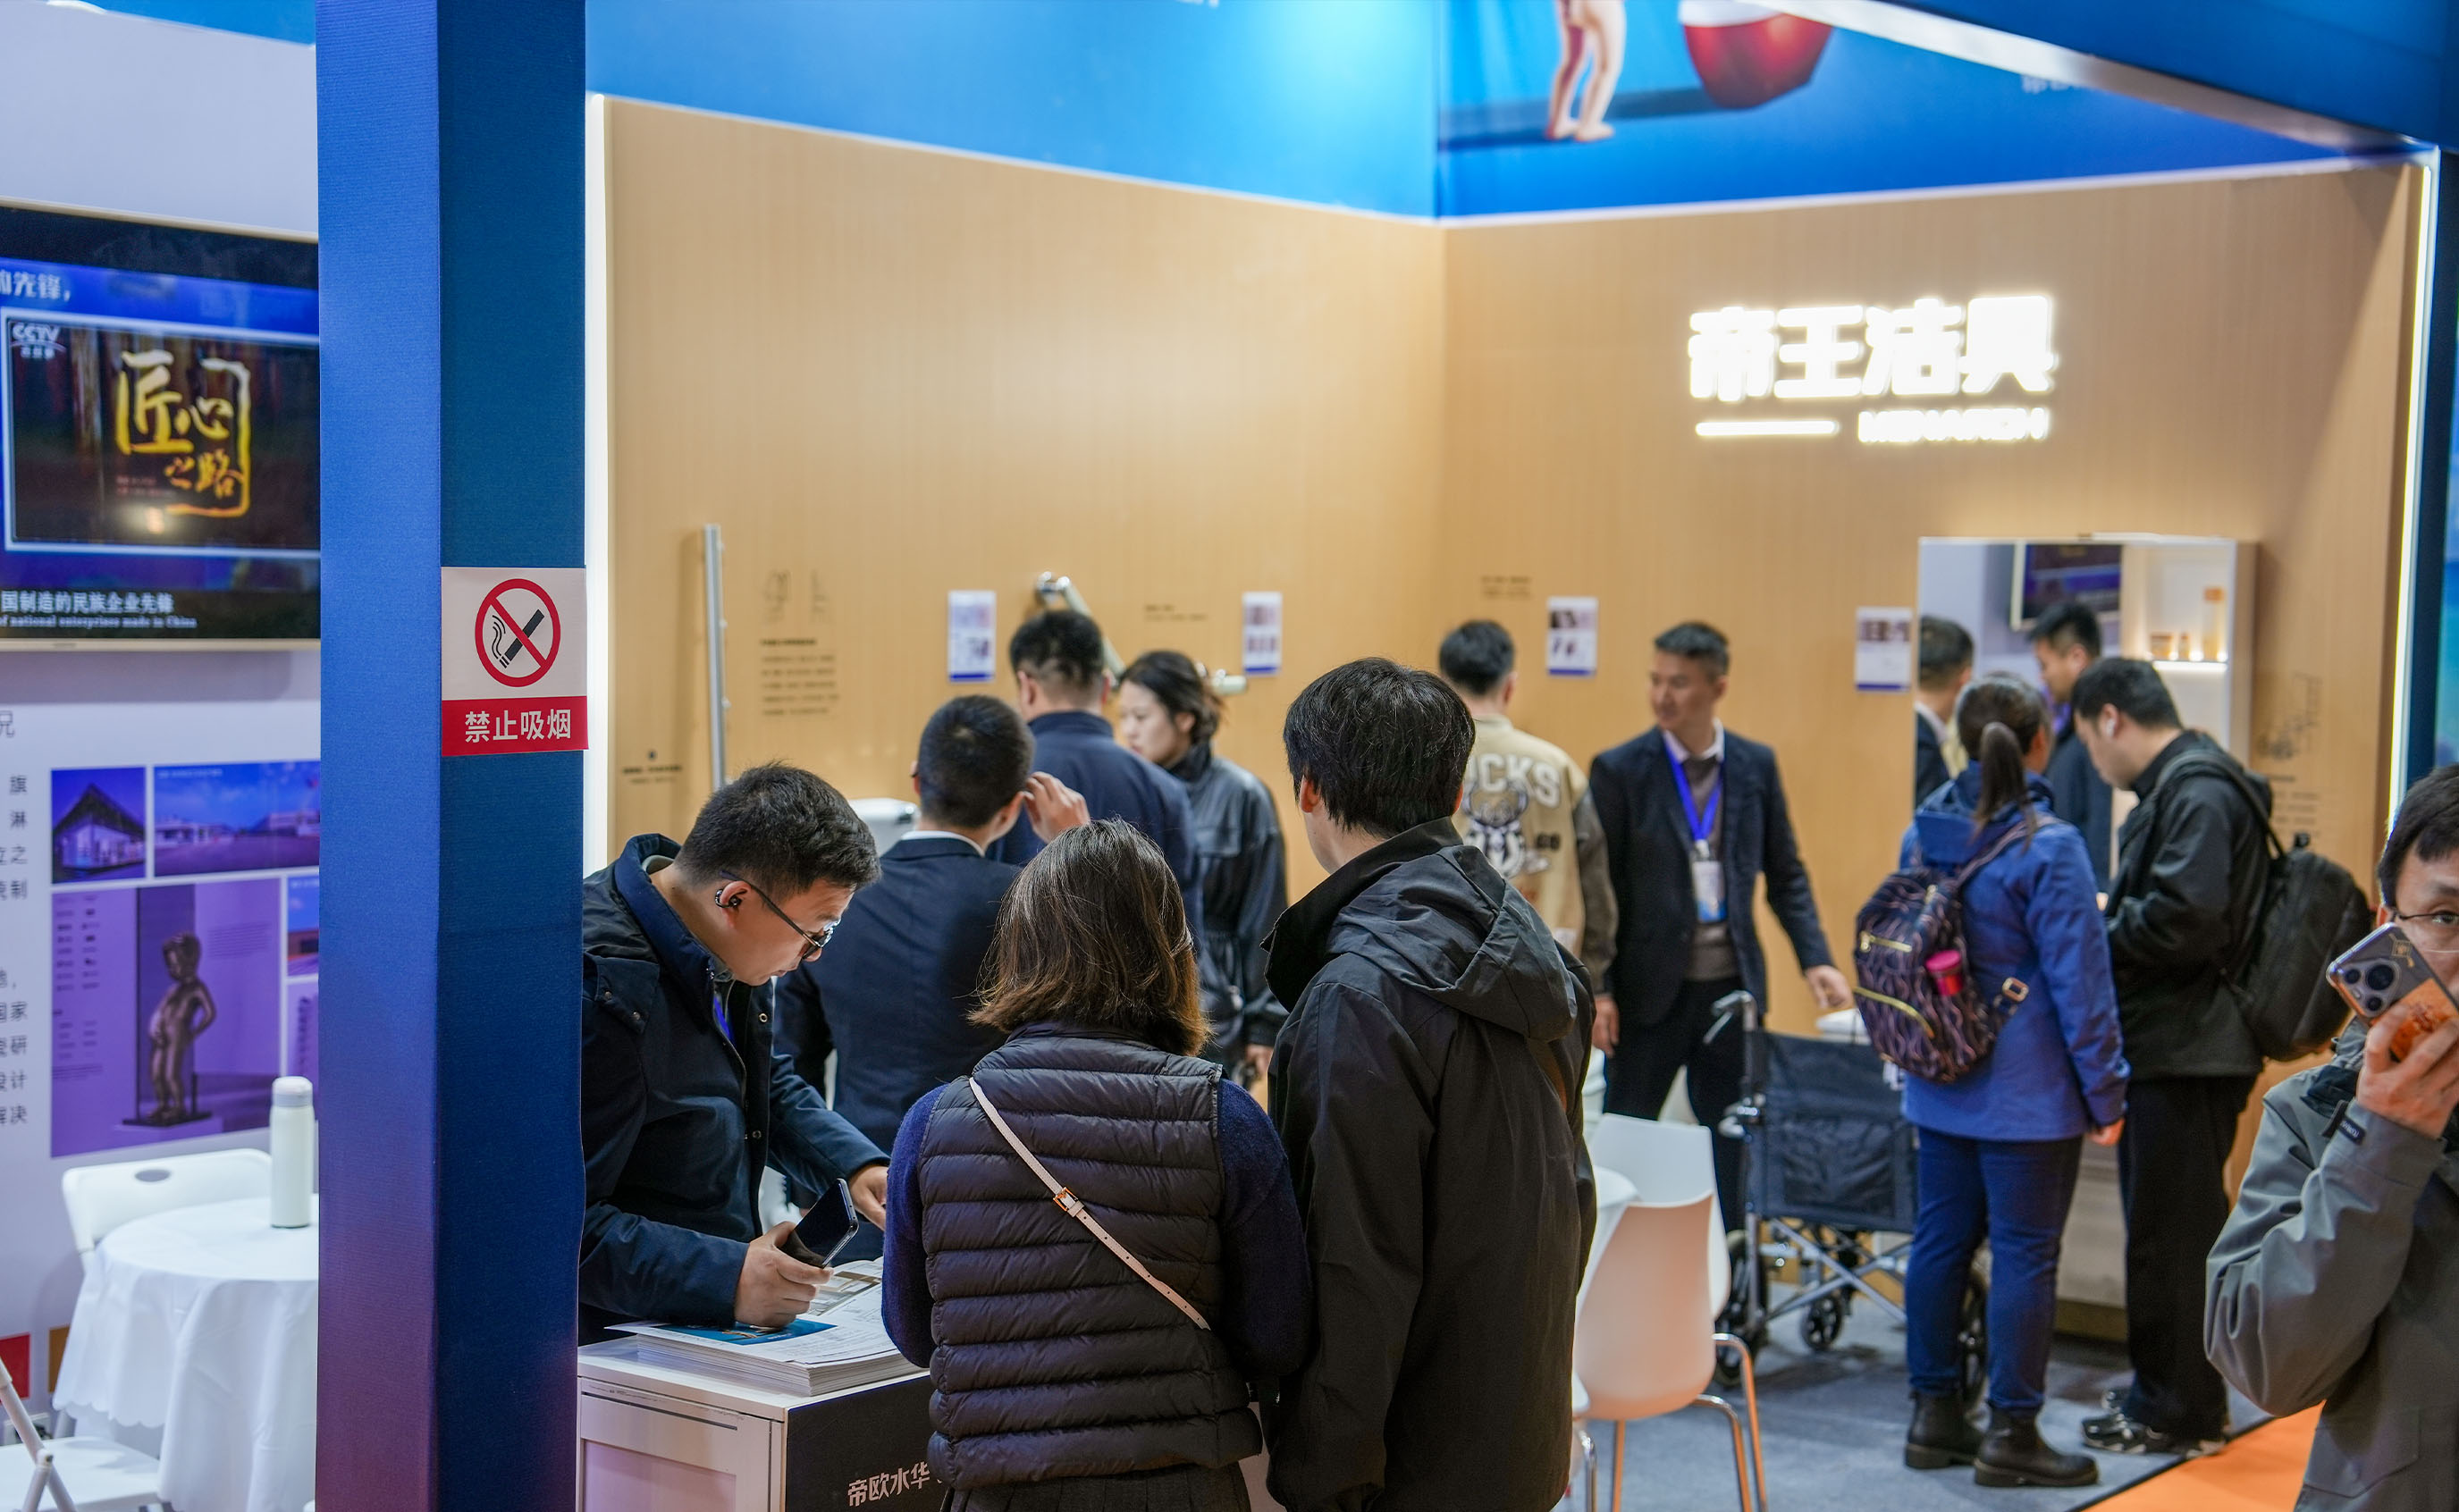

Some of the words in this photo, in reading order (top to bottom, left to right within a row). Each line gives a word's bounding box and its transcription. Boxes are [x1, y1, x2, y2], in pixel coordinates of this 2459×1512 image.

[13, 323, 60, 341] CCTV
[465, 709, 571, 743] 禁止吸烟
[847, 1461, 931, 1507] 帝欧水华
